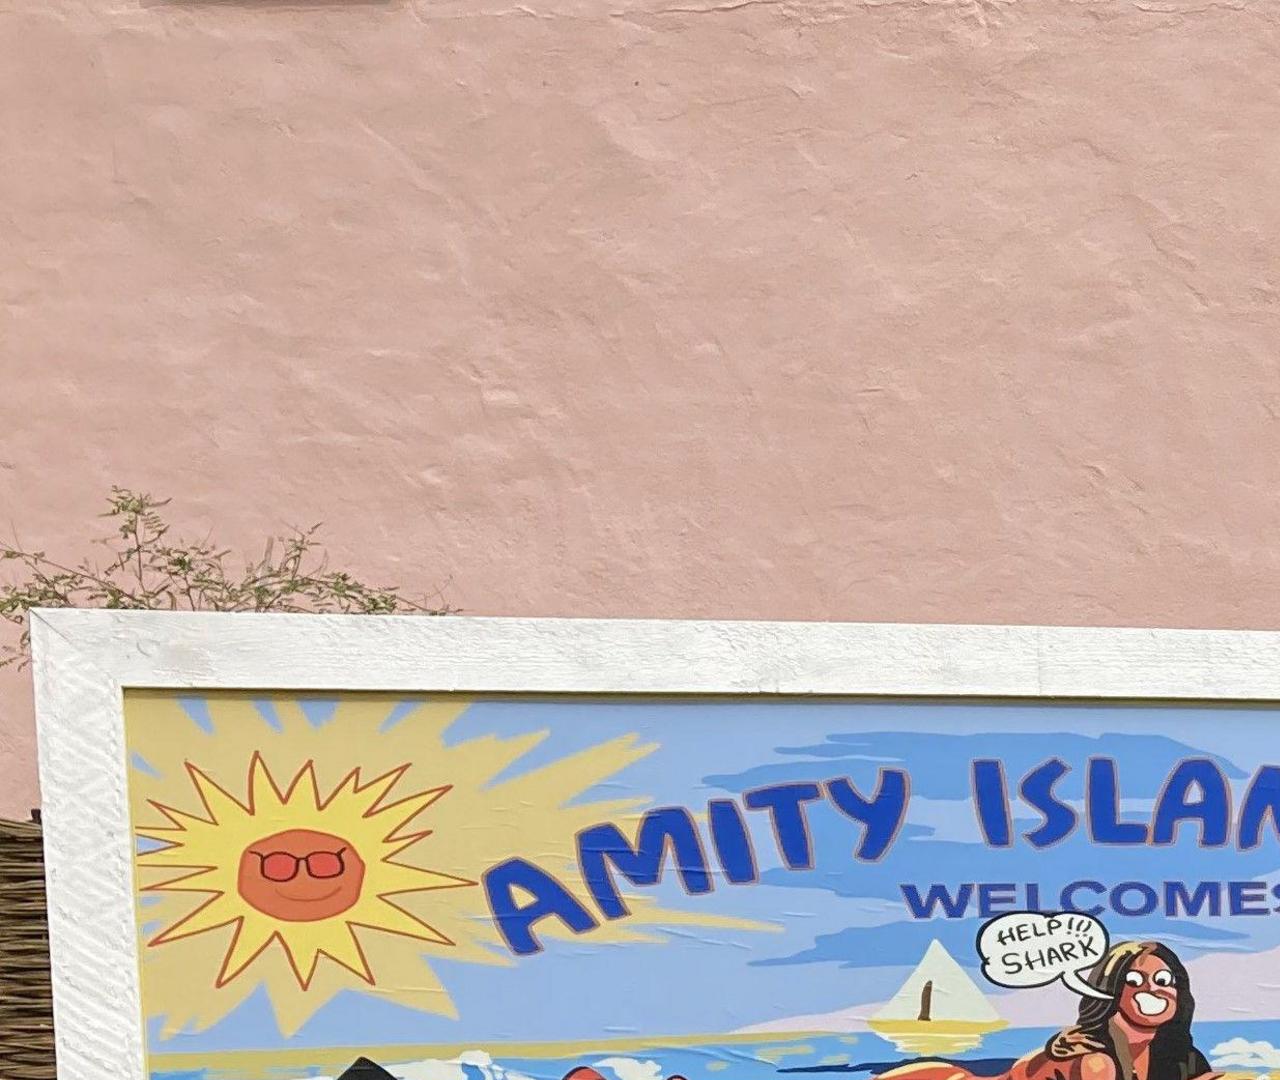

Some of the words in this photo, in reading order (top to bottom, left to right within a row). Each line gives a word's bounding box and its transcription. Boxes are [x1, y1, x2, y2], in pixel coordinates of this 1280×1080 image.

[481, 766, 910, 956] AMITY
[997, 917, 1092, 945] HELP!!!
[1001, 936, 1099, 974] SHARK
